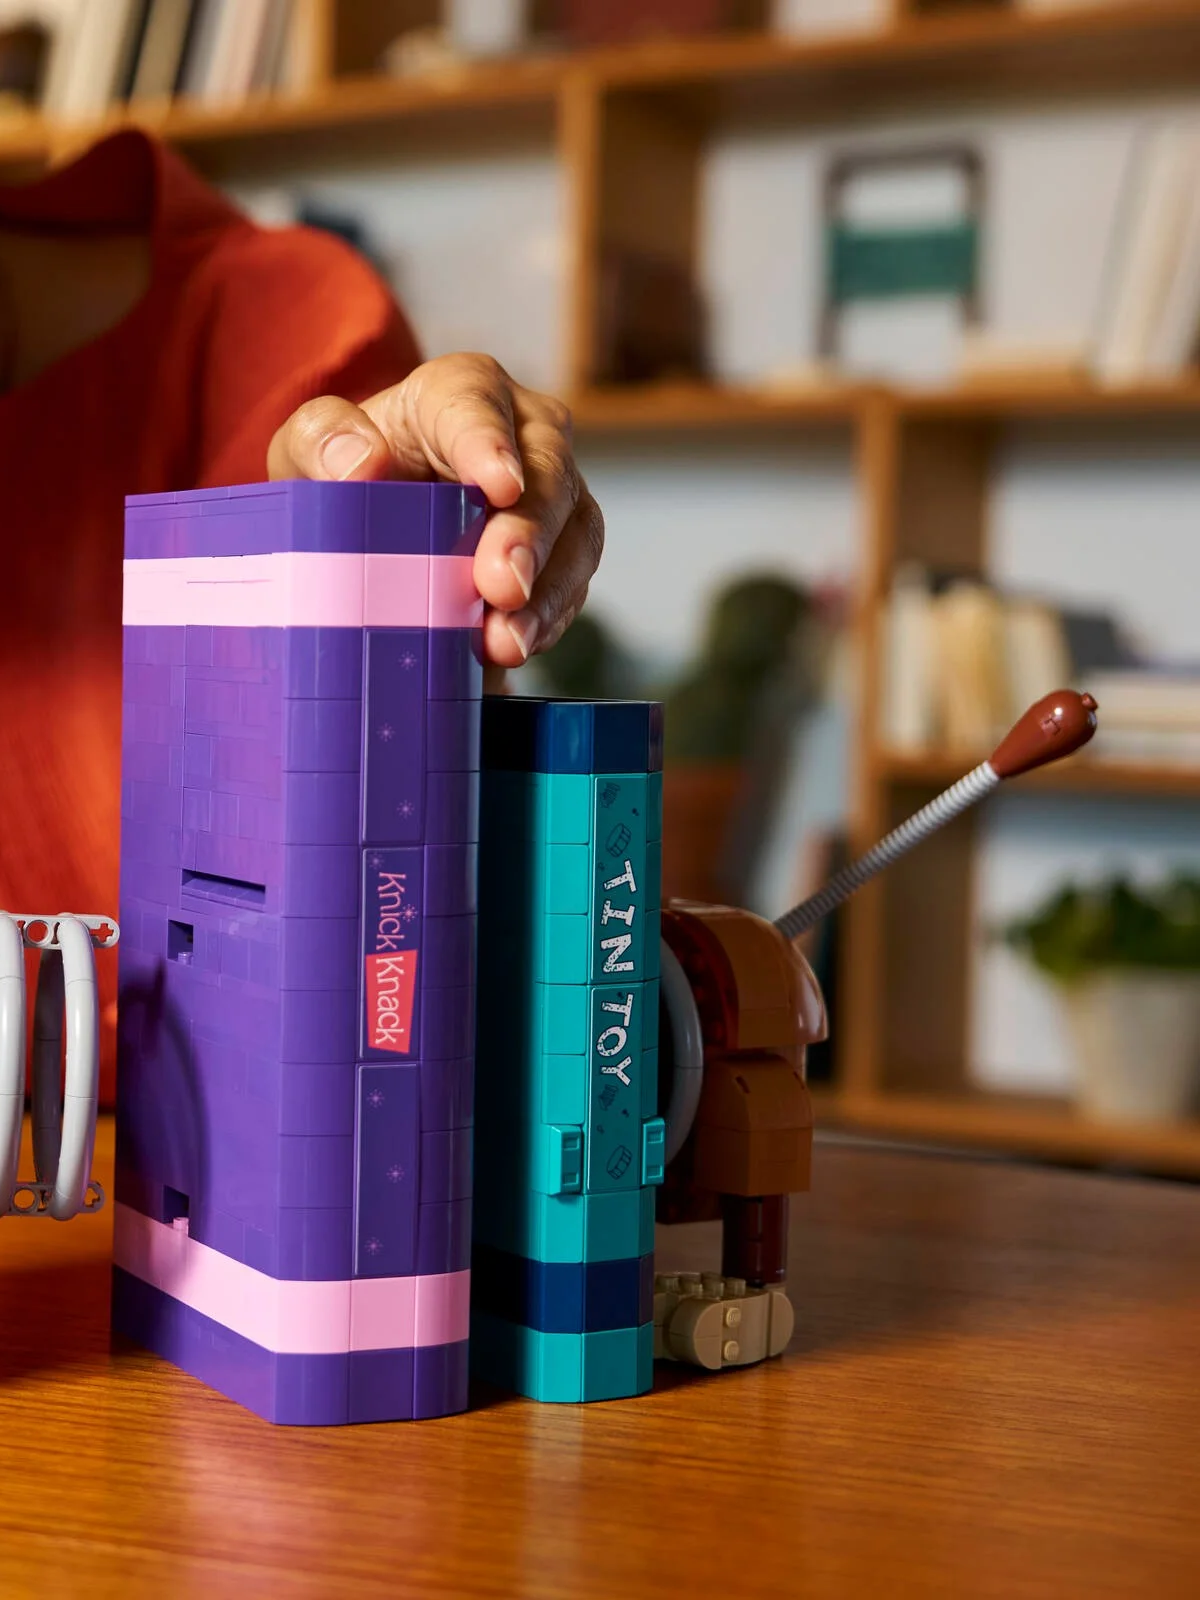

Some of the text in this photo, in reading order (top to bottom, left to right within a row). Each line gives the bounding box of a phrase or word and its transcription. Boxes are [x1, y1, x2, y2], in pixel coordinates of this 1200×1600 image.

[375, 871, 417, 1044] Knick Knack
[596, 860, 637, 1086] TIN TOY
